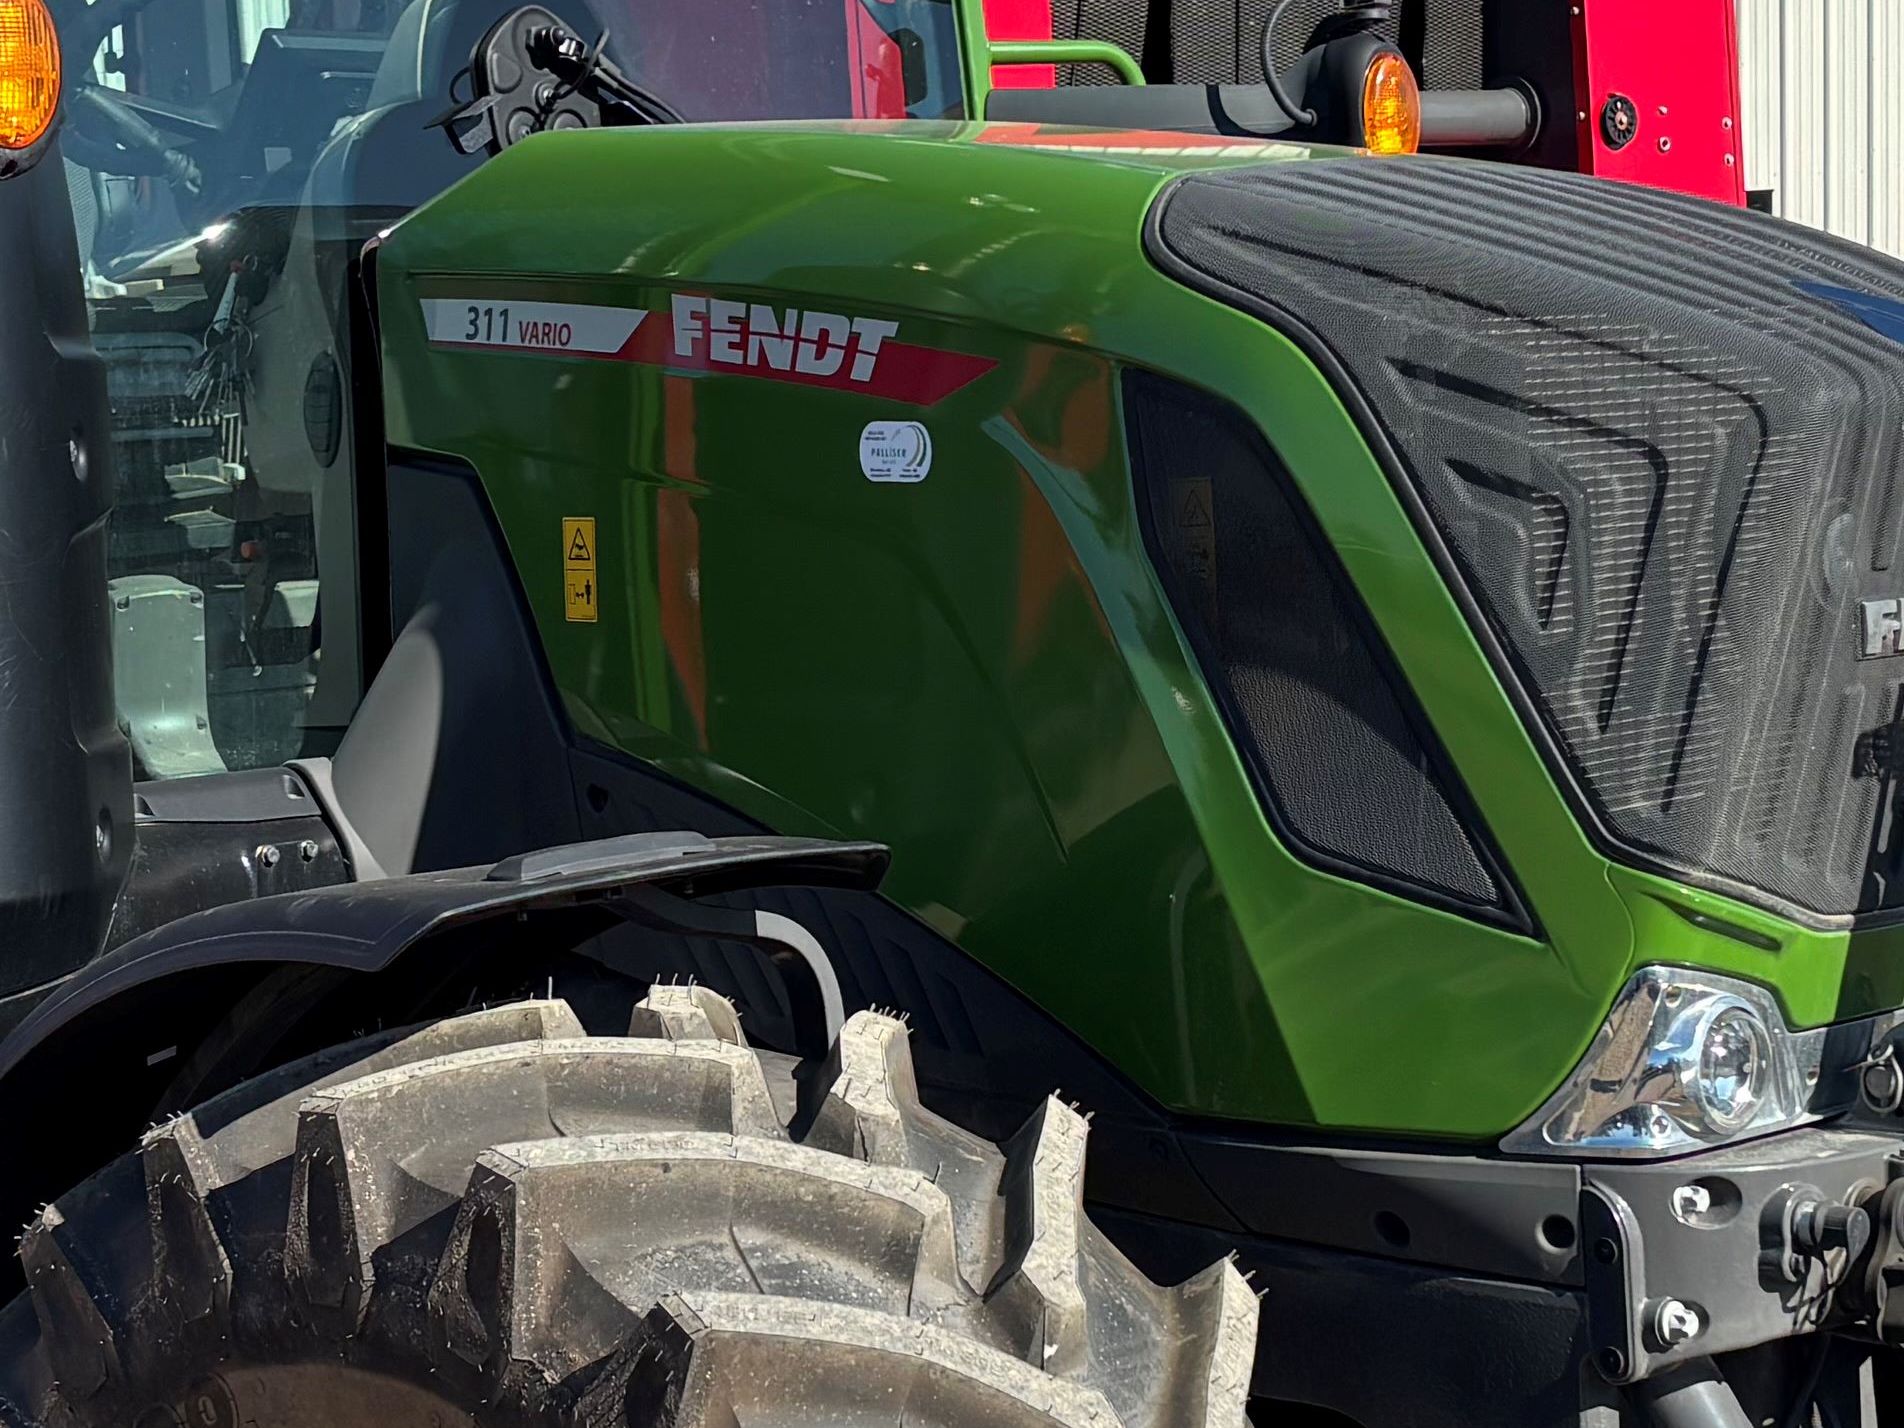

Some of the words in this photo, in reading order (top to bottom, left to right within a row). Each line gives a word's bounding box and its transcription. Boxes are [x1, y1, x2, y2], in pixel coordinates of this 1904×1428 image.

[464, 305, 510, 345] 311
[517, 319, 573, 349] VARIO
[670, 292, 899, 383] FENDT
